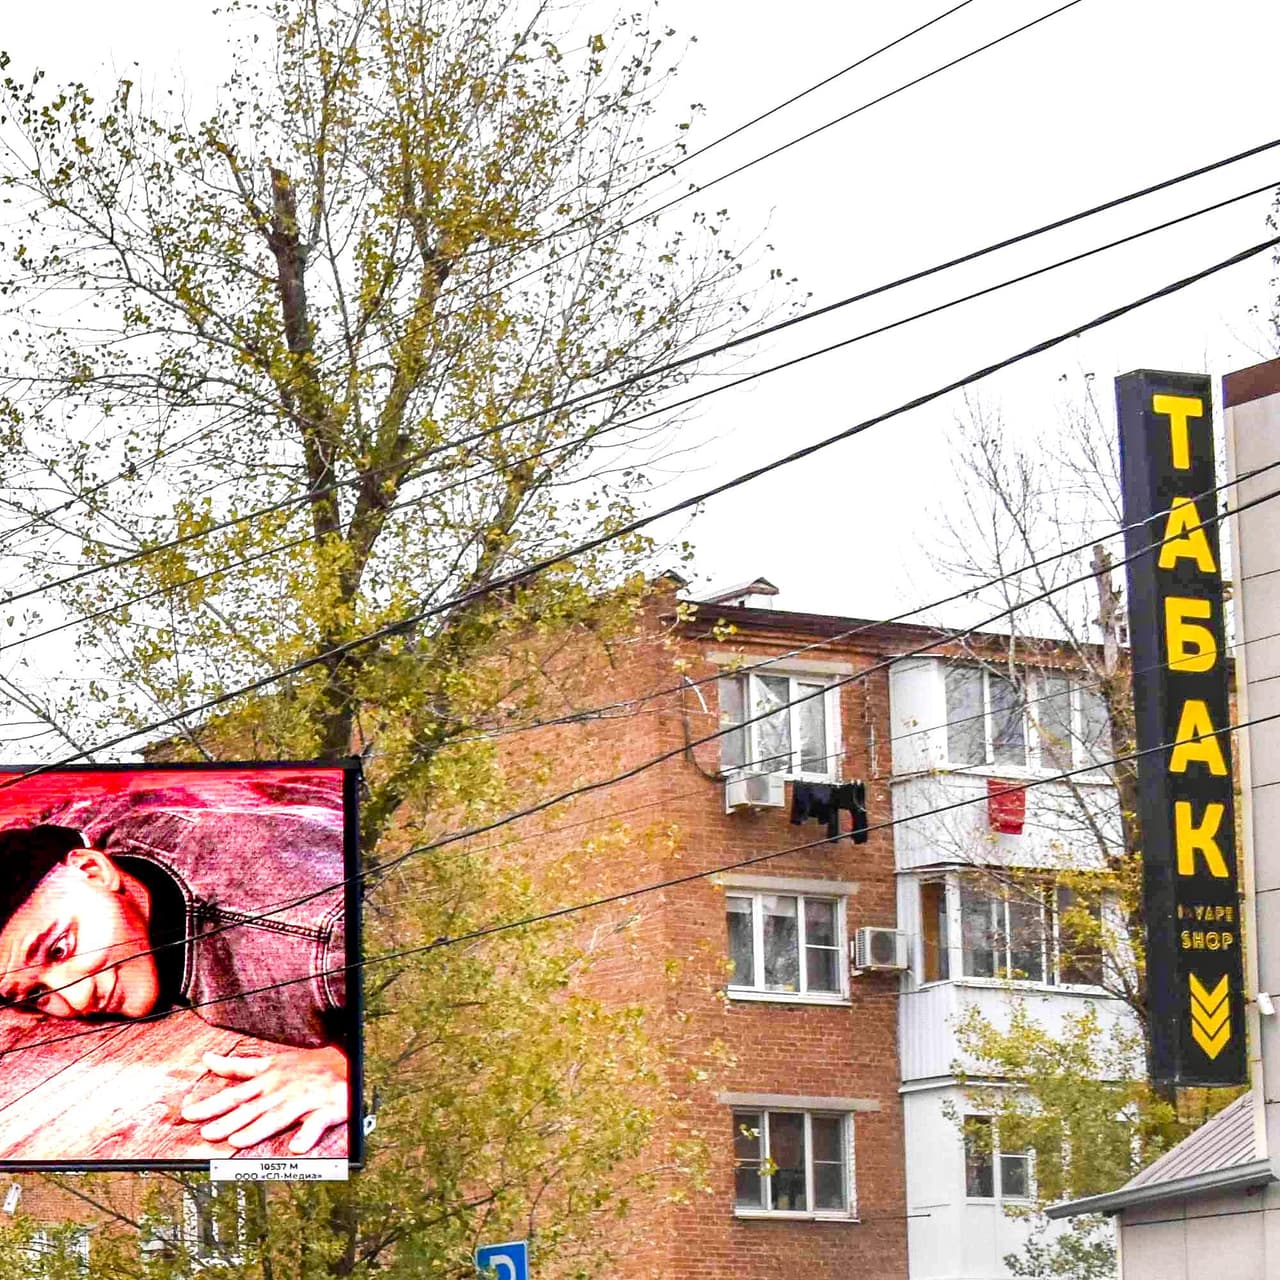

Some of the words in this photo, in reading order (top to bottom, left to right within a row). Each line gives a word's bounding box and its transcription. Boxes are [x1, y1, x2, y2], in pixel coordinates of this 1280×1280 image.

[1153, 394, 1229, 878] ТАБАК
[1181, 930, 1233, 950] SHOP
[260, 1162, 287, 1171] 10537
[234, 1172, 258, 1180] ООО
